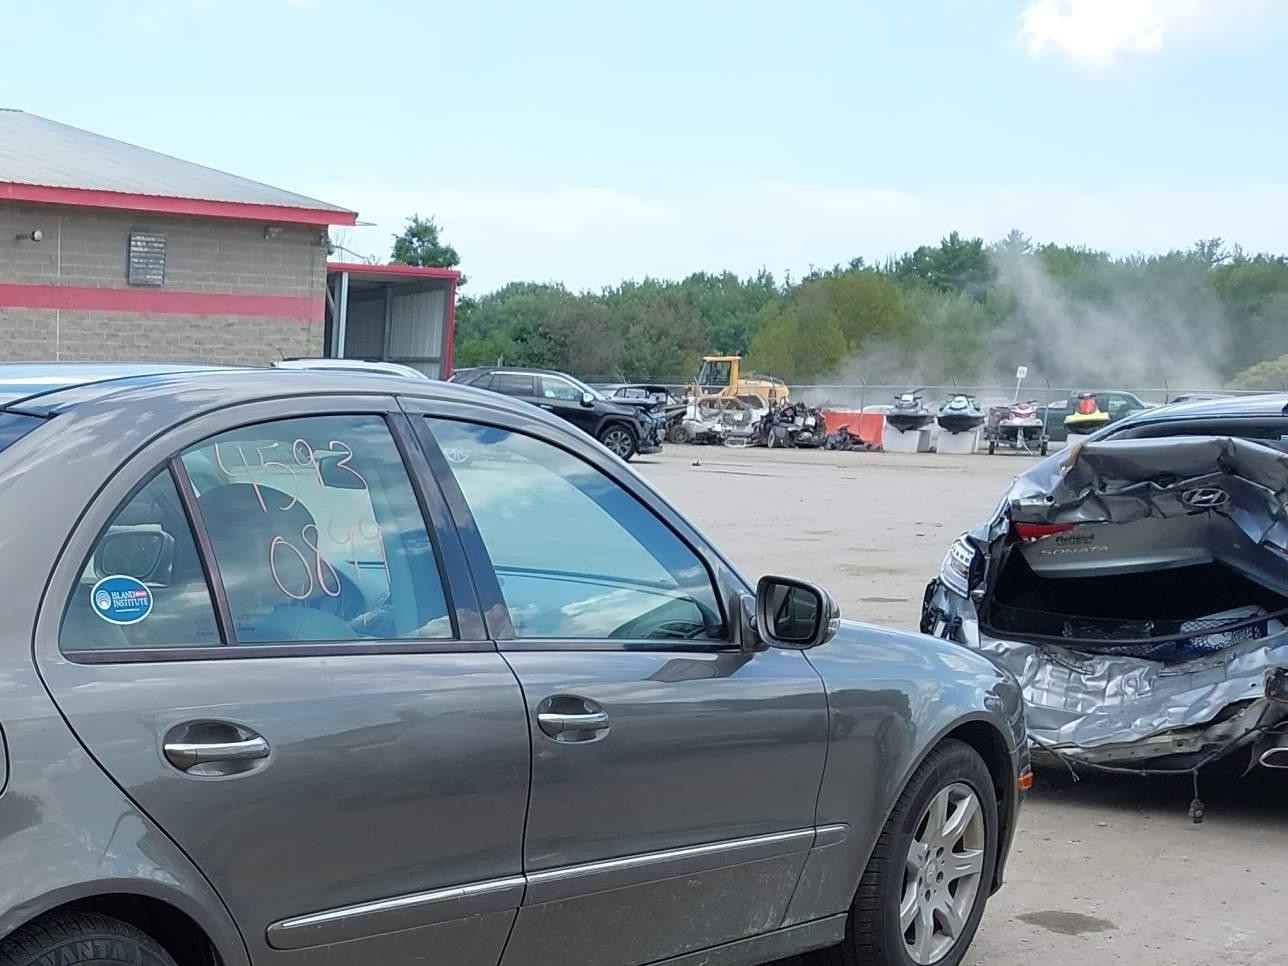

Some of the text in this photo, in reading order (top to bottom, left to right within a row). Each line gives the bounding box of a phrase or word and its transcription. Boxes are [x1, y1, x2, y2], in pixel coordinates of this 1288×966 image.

[214, 438, 369, 513] 4593
[111, 591, 136, 599] ISLAND
[113, 598, 149, 608] INSTITUTE
